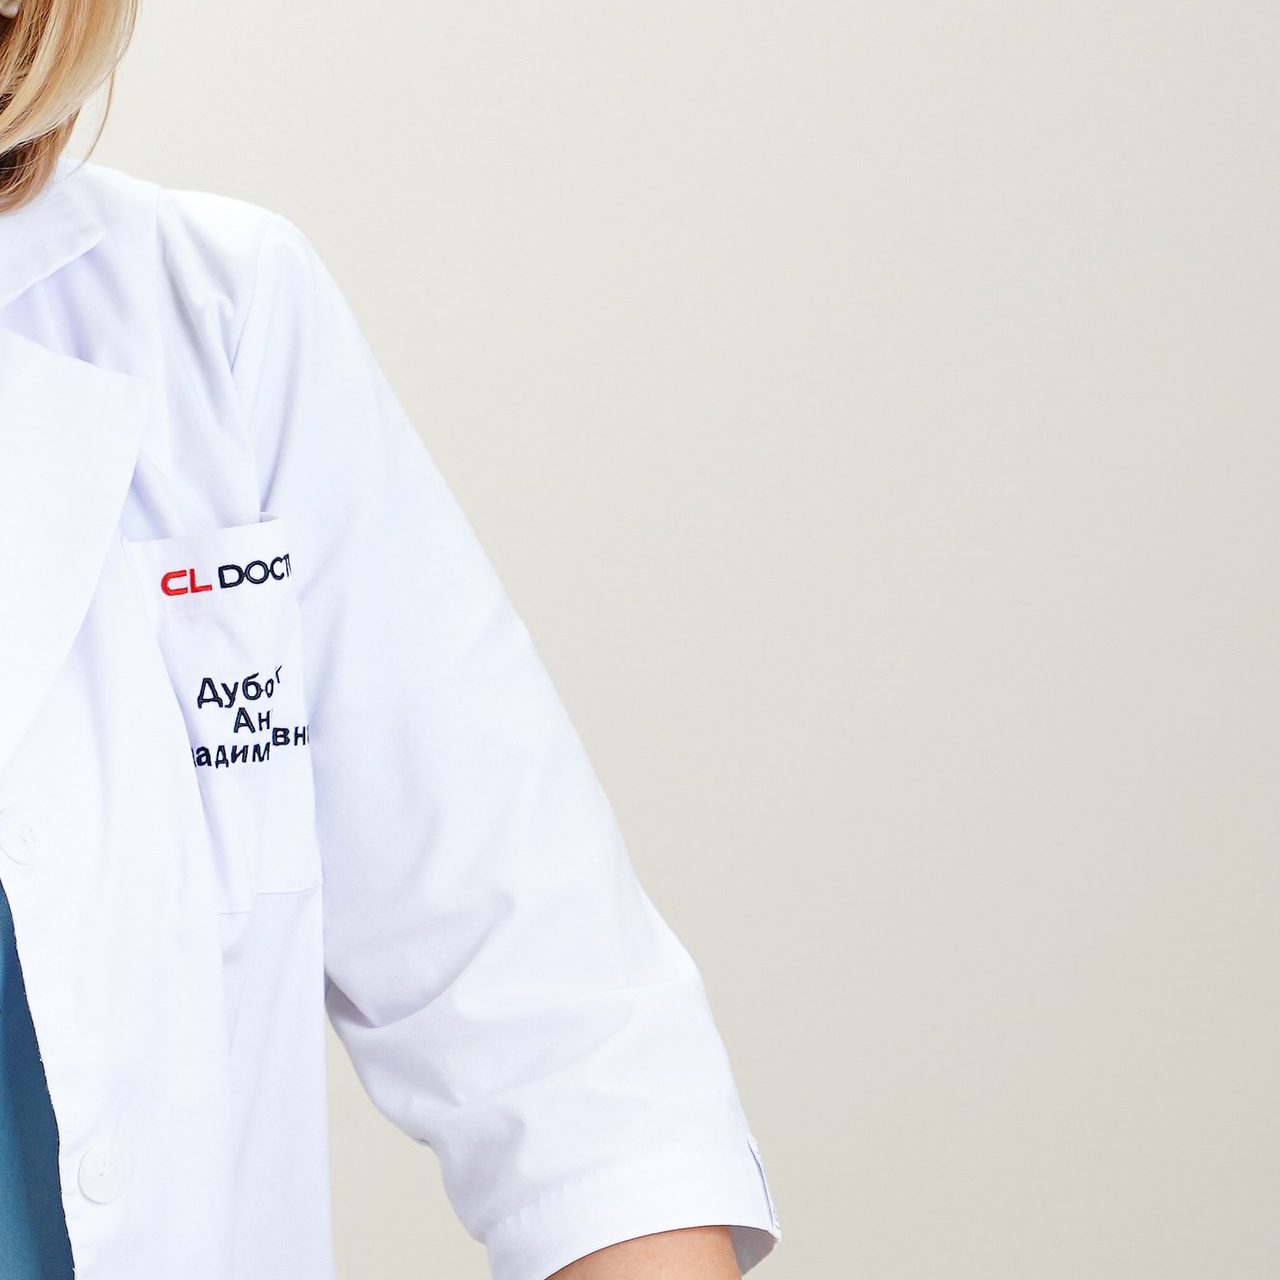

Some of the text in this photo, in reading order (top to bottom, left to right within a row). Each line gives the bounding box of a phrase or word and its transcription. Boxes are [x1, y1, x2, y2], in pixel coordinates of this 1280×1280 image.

[161, 553, 291, 596] CL DOCT
[233, 707, 272, 734] Ан
